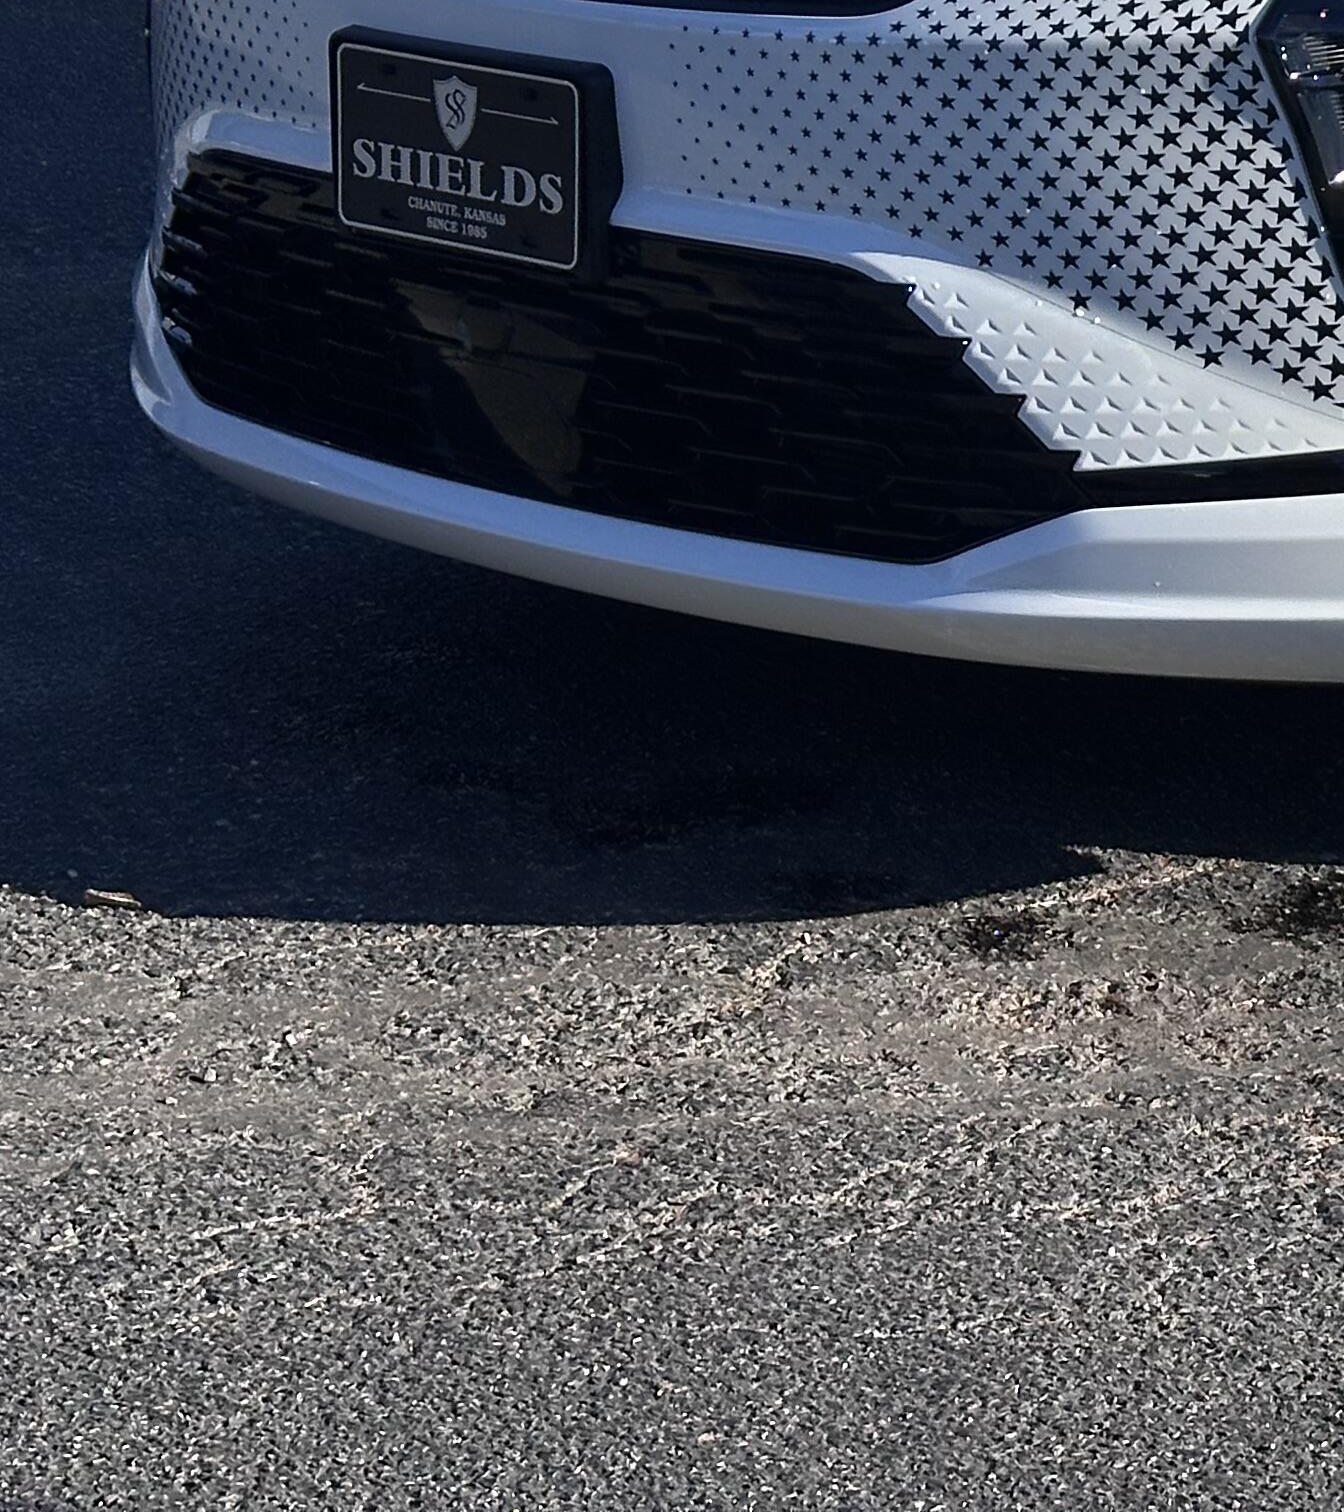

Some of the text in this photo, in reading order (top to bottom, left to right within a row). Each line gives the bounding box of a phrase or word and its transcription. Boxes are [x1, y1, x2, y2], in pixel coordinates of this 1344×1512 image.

[352, 138, 564, 215] SHIELDS
[426, 216, 458, 233] SINCE
[463, 206, 506, 226] KANSAS
